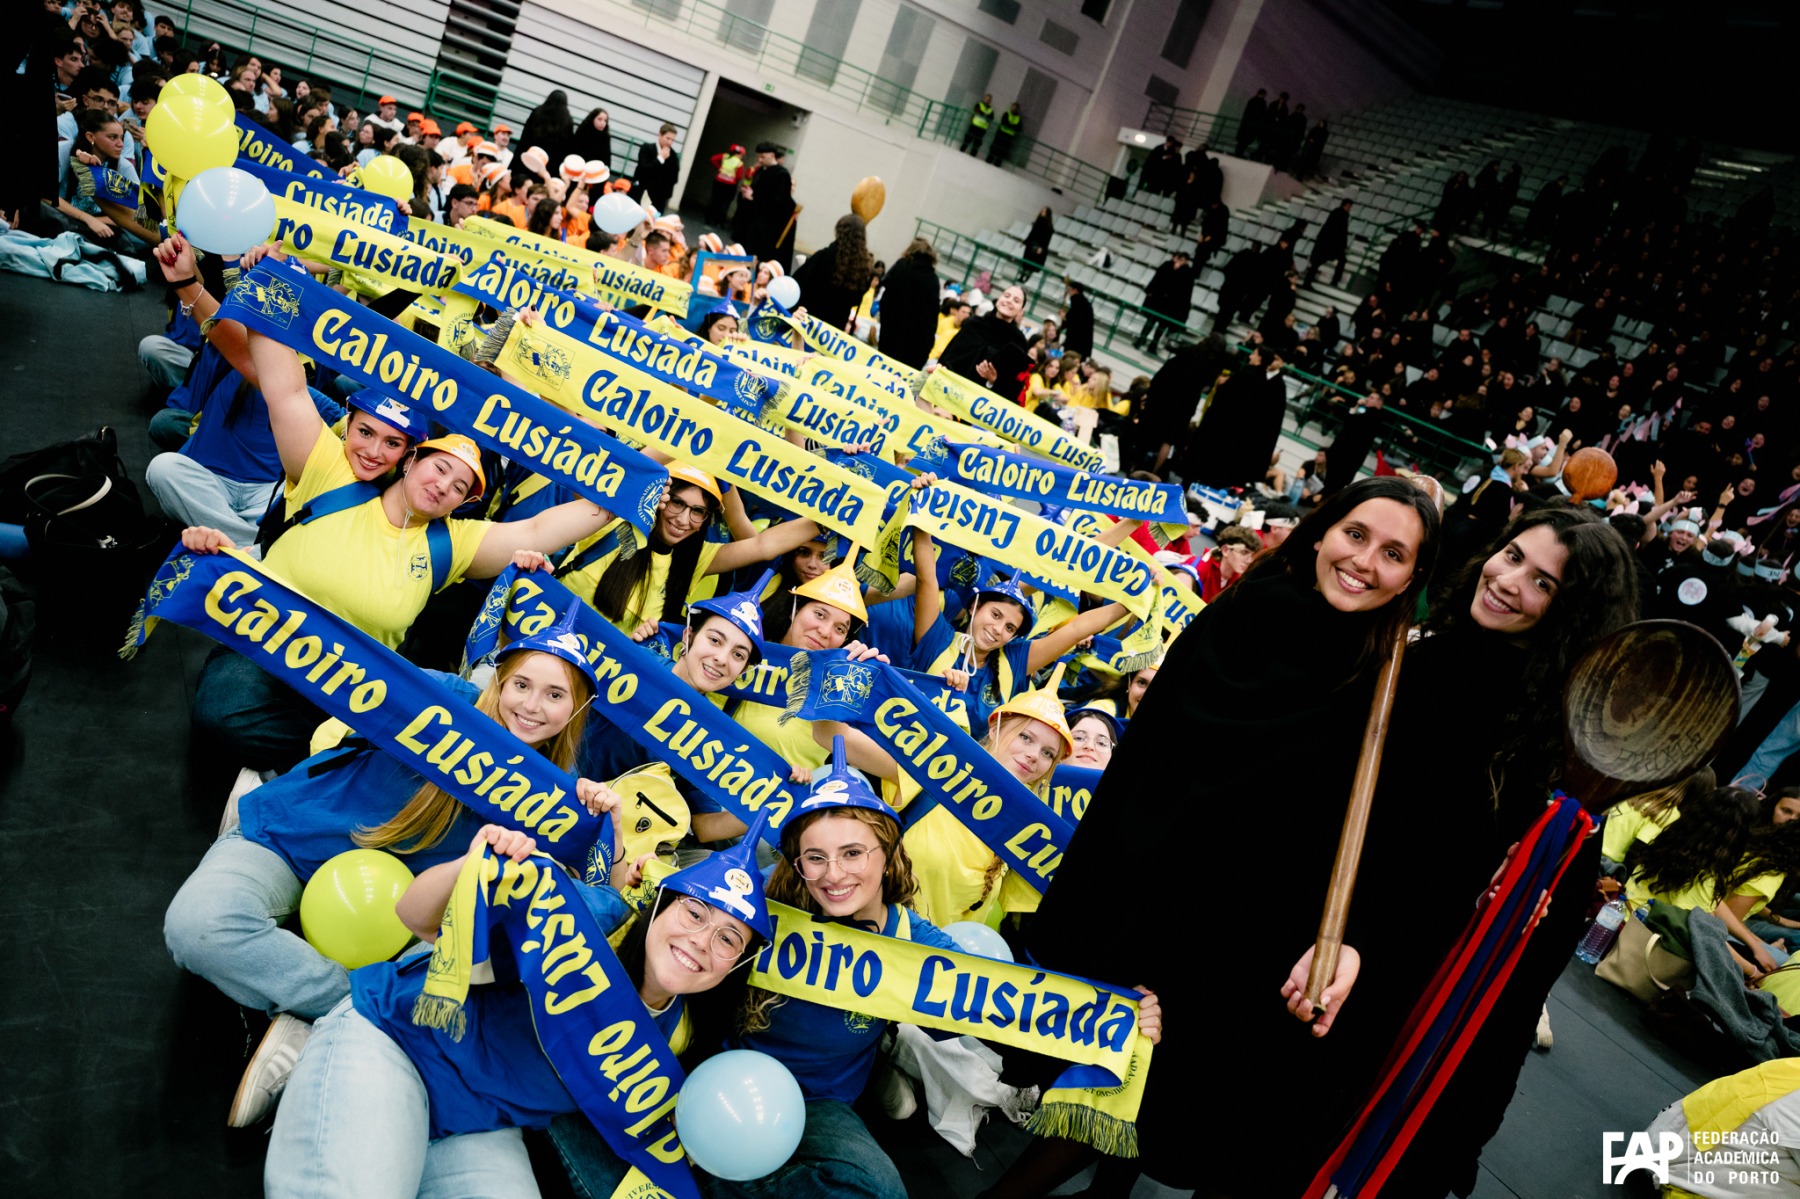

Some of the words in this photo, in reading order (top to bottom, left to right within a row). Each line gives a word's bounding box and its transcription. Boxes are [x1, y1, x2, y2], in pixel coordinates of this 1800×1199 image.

[235, 125, 293, 172] aloiro
[331, 229, 456, 289] Lusíada
[403, 229, 473, 266] aloiro
[588, 311, 717, 388] Lusíada
[312, 309, 458, 412] Caloiro
[473, 394, 626, 498] Lusíada
[786, 393, 887, 457] Lusíada
[970, 397, 1042, 446] Caloiro
[1049, 437, 1106, 474] Lusía
[583, 369, 713, 457] Caloiro
[726, 439, 864, 526] Lusíada
[957, 448, 1055, 495] Caloiro
[1067, 471, 1168, 515] Lusíada
[1036, 528, 1150, 597] Caloiro
[205, 571, 387, 713] Caloiro
[394, 705, 580, 843] Lusíada
[506, 578, 638, 704] Cairo
[642, 698, 794, 829] Lusíada
[874, 697, 1003, 821] Caloiro
[756, 915, 883, 998] loiro
[911, 954, 1135, 1052] Lusíada
